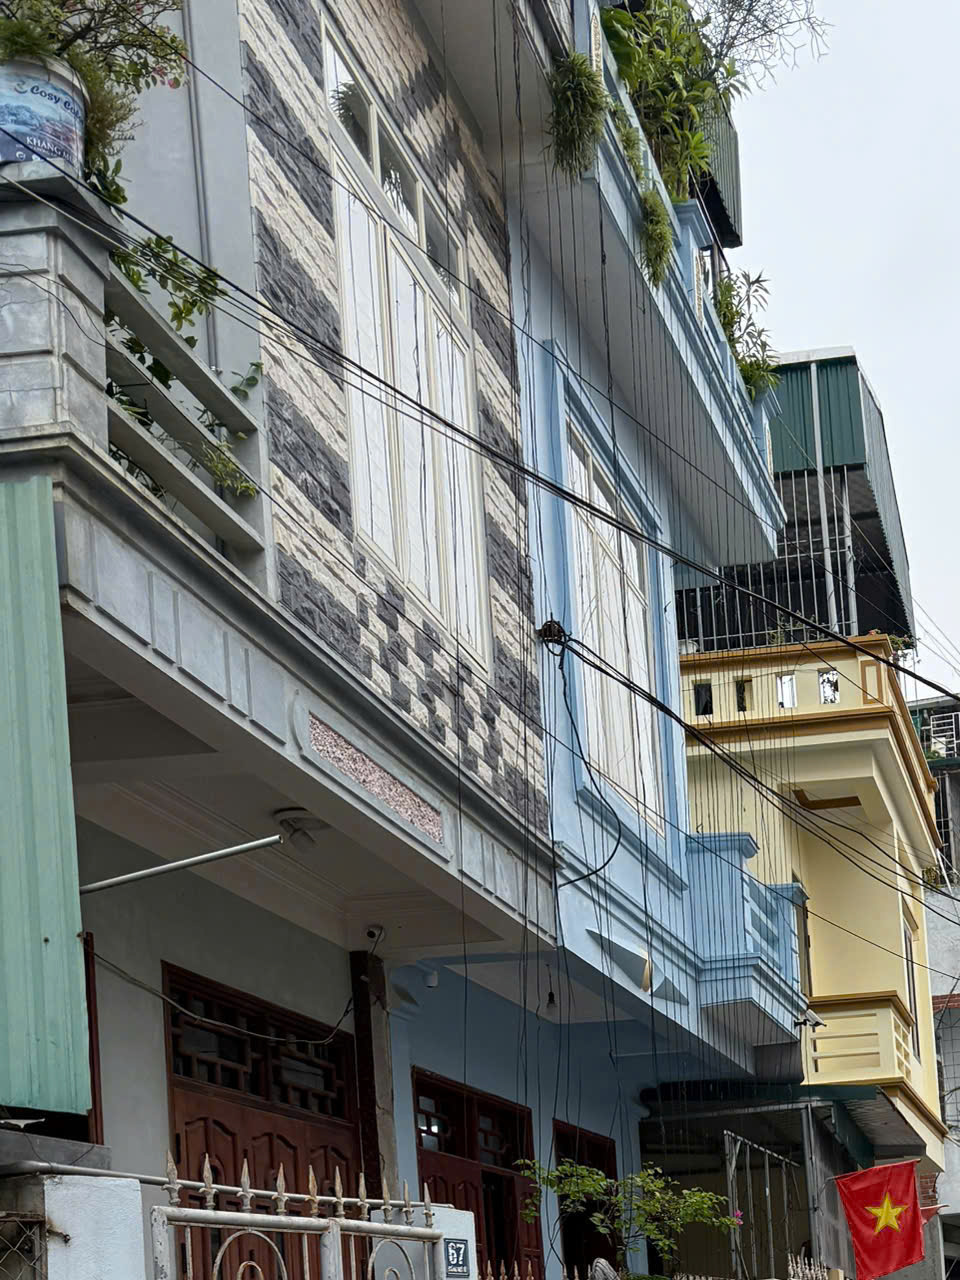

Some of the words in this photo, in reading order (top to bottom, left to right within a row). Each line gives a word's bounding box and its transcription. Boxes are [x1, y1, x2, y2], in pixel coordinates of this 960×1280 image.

[30, 85, 61, 104] Cosy
[26, 136, 61, 156] KHANG
[448, 1242, 465, 1265] 67
